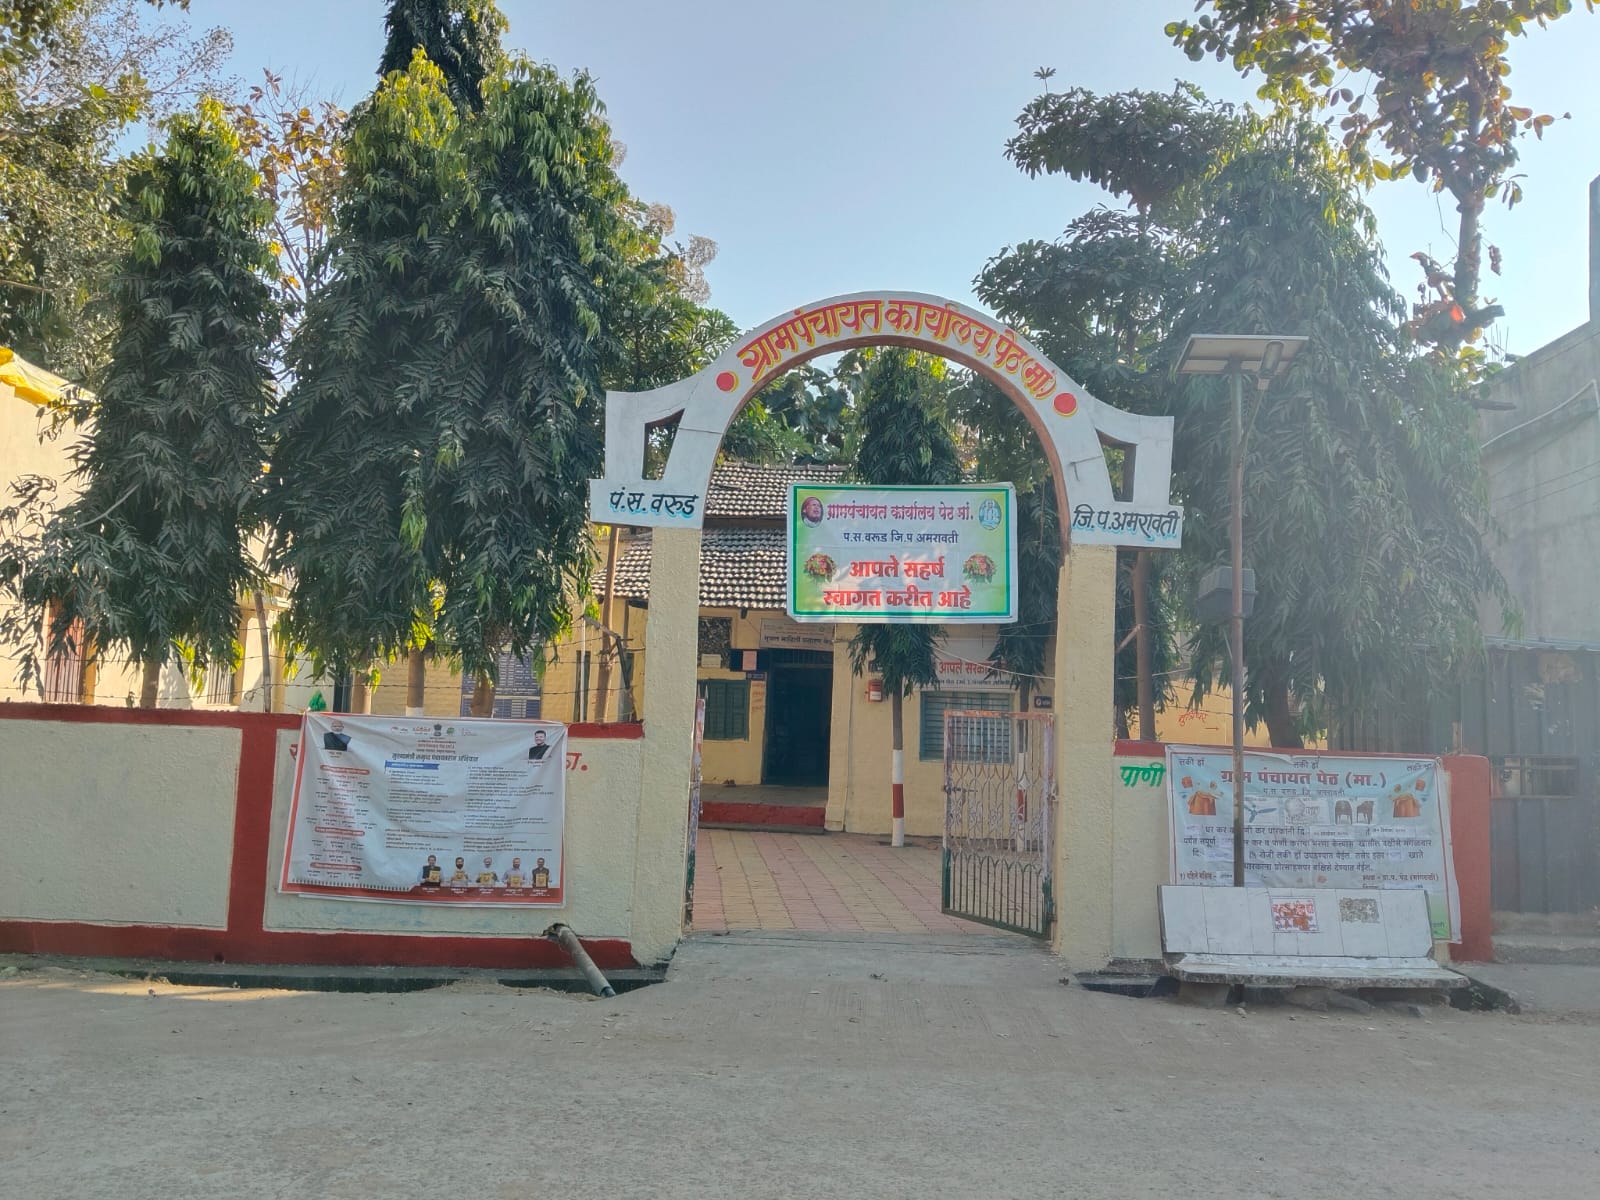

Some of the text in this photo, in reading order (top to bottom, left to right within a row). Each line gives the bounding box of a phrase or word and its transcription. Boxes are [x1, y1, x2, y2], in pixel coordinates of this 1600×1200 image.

[736, 299, 883, 380] ग्रामपंचायत
[994, 328, 1028, 373] पेठ
[827, 500, 886, 520] ग्रामपंचायत
[891, 501, 935, 520] कार्यालय
[938, 501, 954, 520] पेठ
[916, 530, 959, 543] अमरावती
[850, 555, 945, 580] आपले सहर्ष
[823, 584, 972, 609] स्वागत करीत आहे
[1120, 762, 1166, 787] पाणी
[1257, 767, 1312, 785] पंचायत
[1316, 770, 1339, 785] पेठ
